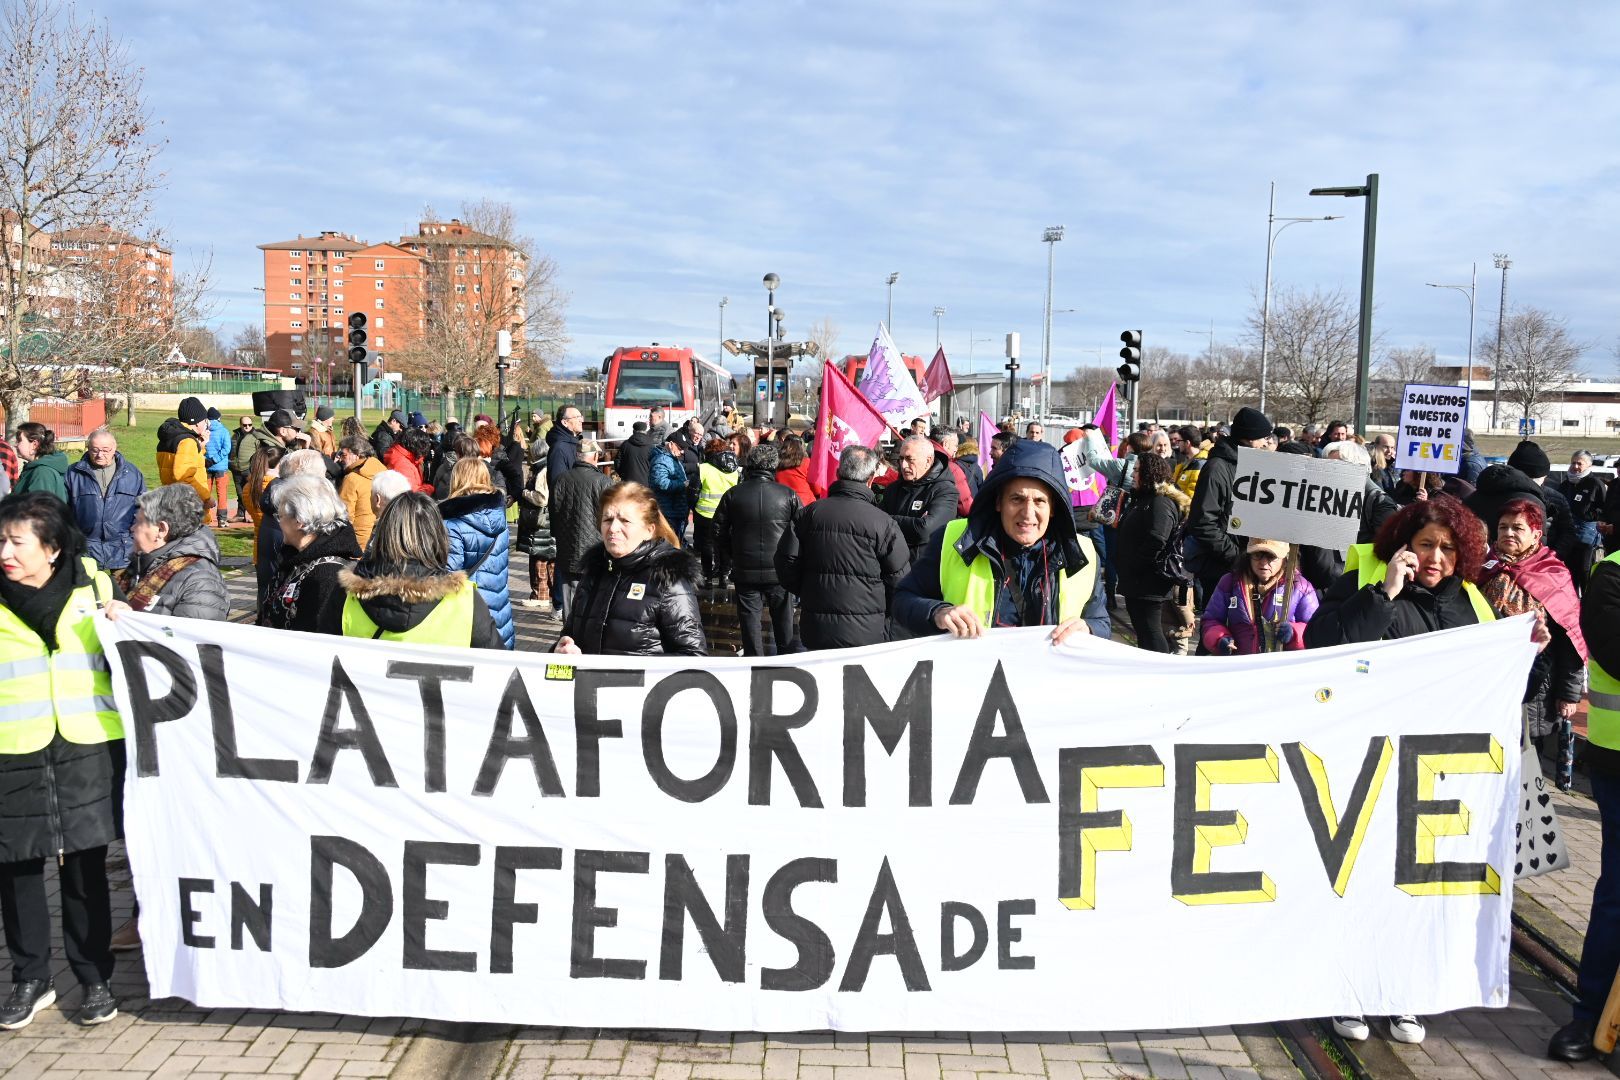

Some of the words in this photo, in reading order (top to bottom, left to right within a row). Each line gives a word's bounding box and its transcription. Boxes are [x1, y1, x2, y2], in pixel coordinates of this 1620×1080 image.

[1405, 425, 1433, 437] TREN
[1437, 428, 1452, 439] DE
[1409, 409, 1460, 423] NUESTRO
[115, 638, 1050, 808] PLATAFORMA
[178, 877, 274, 952] EN
[309, 834, 932, 992] DEFENSA
[940, 898, 1036, 972] DE
[1057, 732, 1504, 911] FEVE
